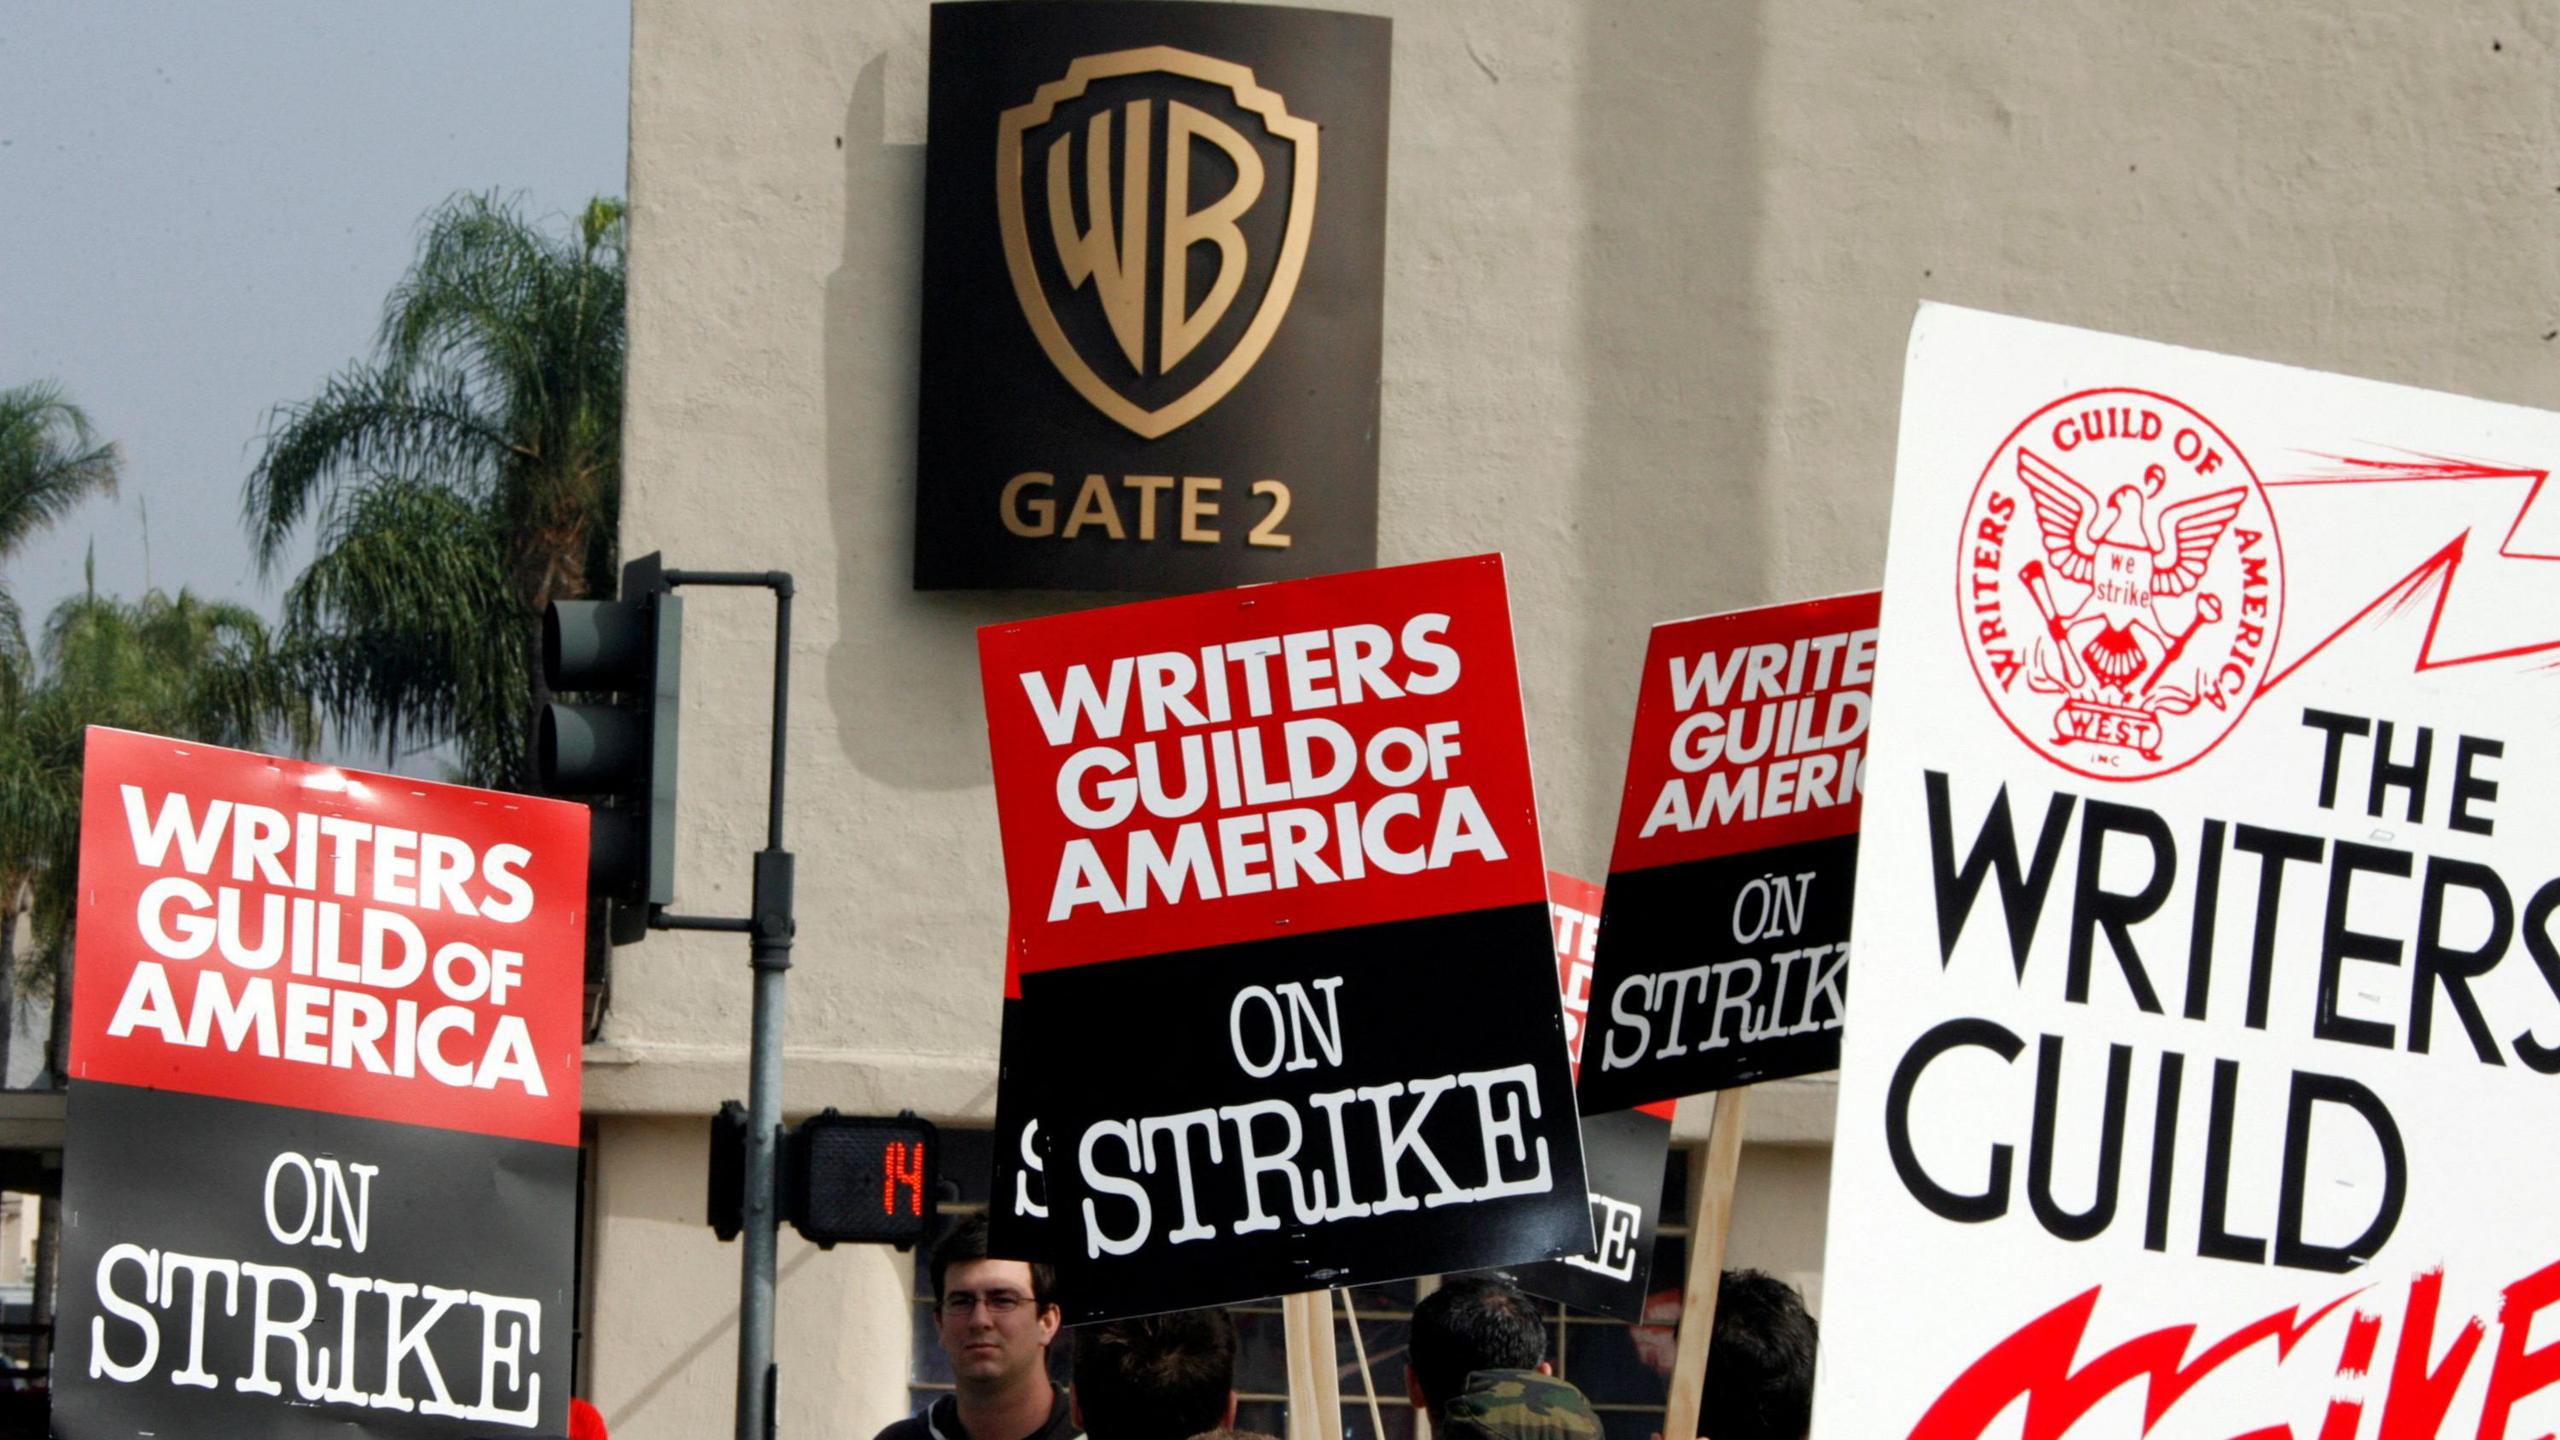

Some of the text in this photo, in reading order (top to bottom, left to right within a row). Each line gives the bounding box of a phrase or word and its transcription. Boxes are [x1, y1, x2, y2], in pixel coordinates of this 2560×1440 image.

[1048, 99, 1265, 376] WB
[1000, 471, 1292, 548] GATE 2
[1973, 406, 2269, 712] WRITERS GUILD OF AMERICA
[2110, 553, 2136, 574] we
[2096, 578, 2150, 609] strike
[1019, 612, 1461, 746] WRITERS
[1670, 689, 1872, 773] GUILD
[2069, 709, 2151, 747] WEST
[1056, 717, 1462, 830] GUILD OF
[1638, 747, 1867, 839] AMERI
[2302, 708, 2504, 836] THE
[120, 784, 535, 924] WRITERS
[1046, 785, 1508, 922] AMERICA
[1732, 871, 1816, 944] ON
[136, 877, 524, 1006] GUILD OF
[1923, 769, 2560, 1074] WRITERS
[106, 960, 549, 1098] AMERICA
[1229, 976, 1344, 1078] ON
[263, 1151, 379, 1254] ON
[884, 1141, 924, 1216] 14
[1078, 1063, 1553, 1259] STRIKE
[1885, 1017, 2407, 1274] GUILD
[89, 1242, 542, 1429] STRIKE
